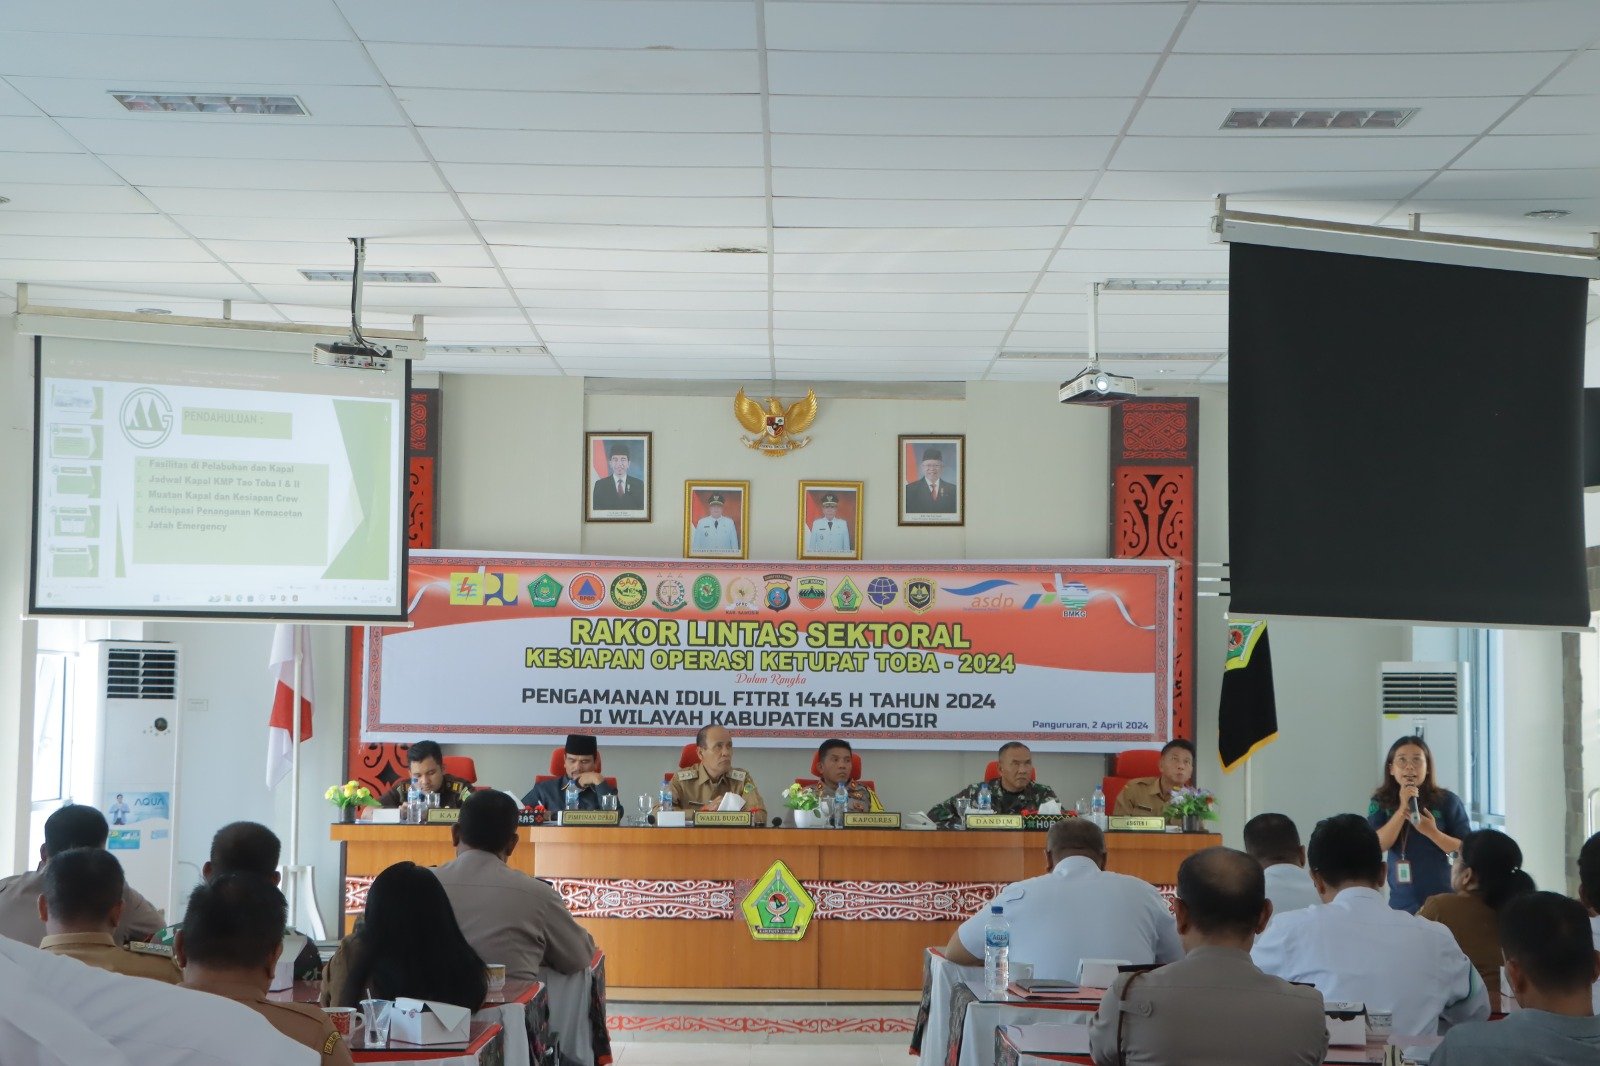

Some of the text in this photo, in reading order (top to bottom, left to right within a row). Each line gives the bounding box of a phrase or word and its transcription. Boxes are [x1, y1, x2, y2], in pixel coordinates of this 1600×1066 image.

[184, 411, 257, 424] PENDAHULUAN
[149, 459, 295, 473] Fasilitas di Pelabuhan dan Kapal
[149, 475, 182, 484] Jadwal
[214, 477, 234, 486] KMP
[236, 478, 253, 487] Tao
[255, 479, 276, 488] Toba
[149, 490, 299, 504] Muatan Kapal dan Kesiapan Crew
[149, 505, 303, 518] Antisipasi Penanganan Kemacetan
[177, 521, 227, 532] Emergency
[618, 578, 638, 587] SAR
[971, 593, 1015, 609] asdp
[1063, 610, 1087, 618] BMKG
[571, 617, 971, 649] RAKOR LINTAS SEKTORAL
[525, 647, 644, 669] KESIAPAN
[651, 649, 754, 671] OPERASI
[760, 650, 869, 672] KETUPAT
[874, 652, 940, 673] TOBA
[958, 653, 1016, 674] 2024
[735, 673, 807, 688] Dalam Rangka
[522, 688, 996, 709] PENGAMANAN IDUL FITRI 1445 H TAHUN 2024
[580, 708, 938, 728] DI WILAYAH KABUPATEN SAMOSIR
[1032, 720, 1149, 730] Pangururan, 2 April 2024
[135, 798, 165, 806] AQUA
[852, 816, 893, 824] KAPOLRES
